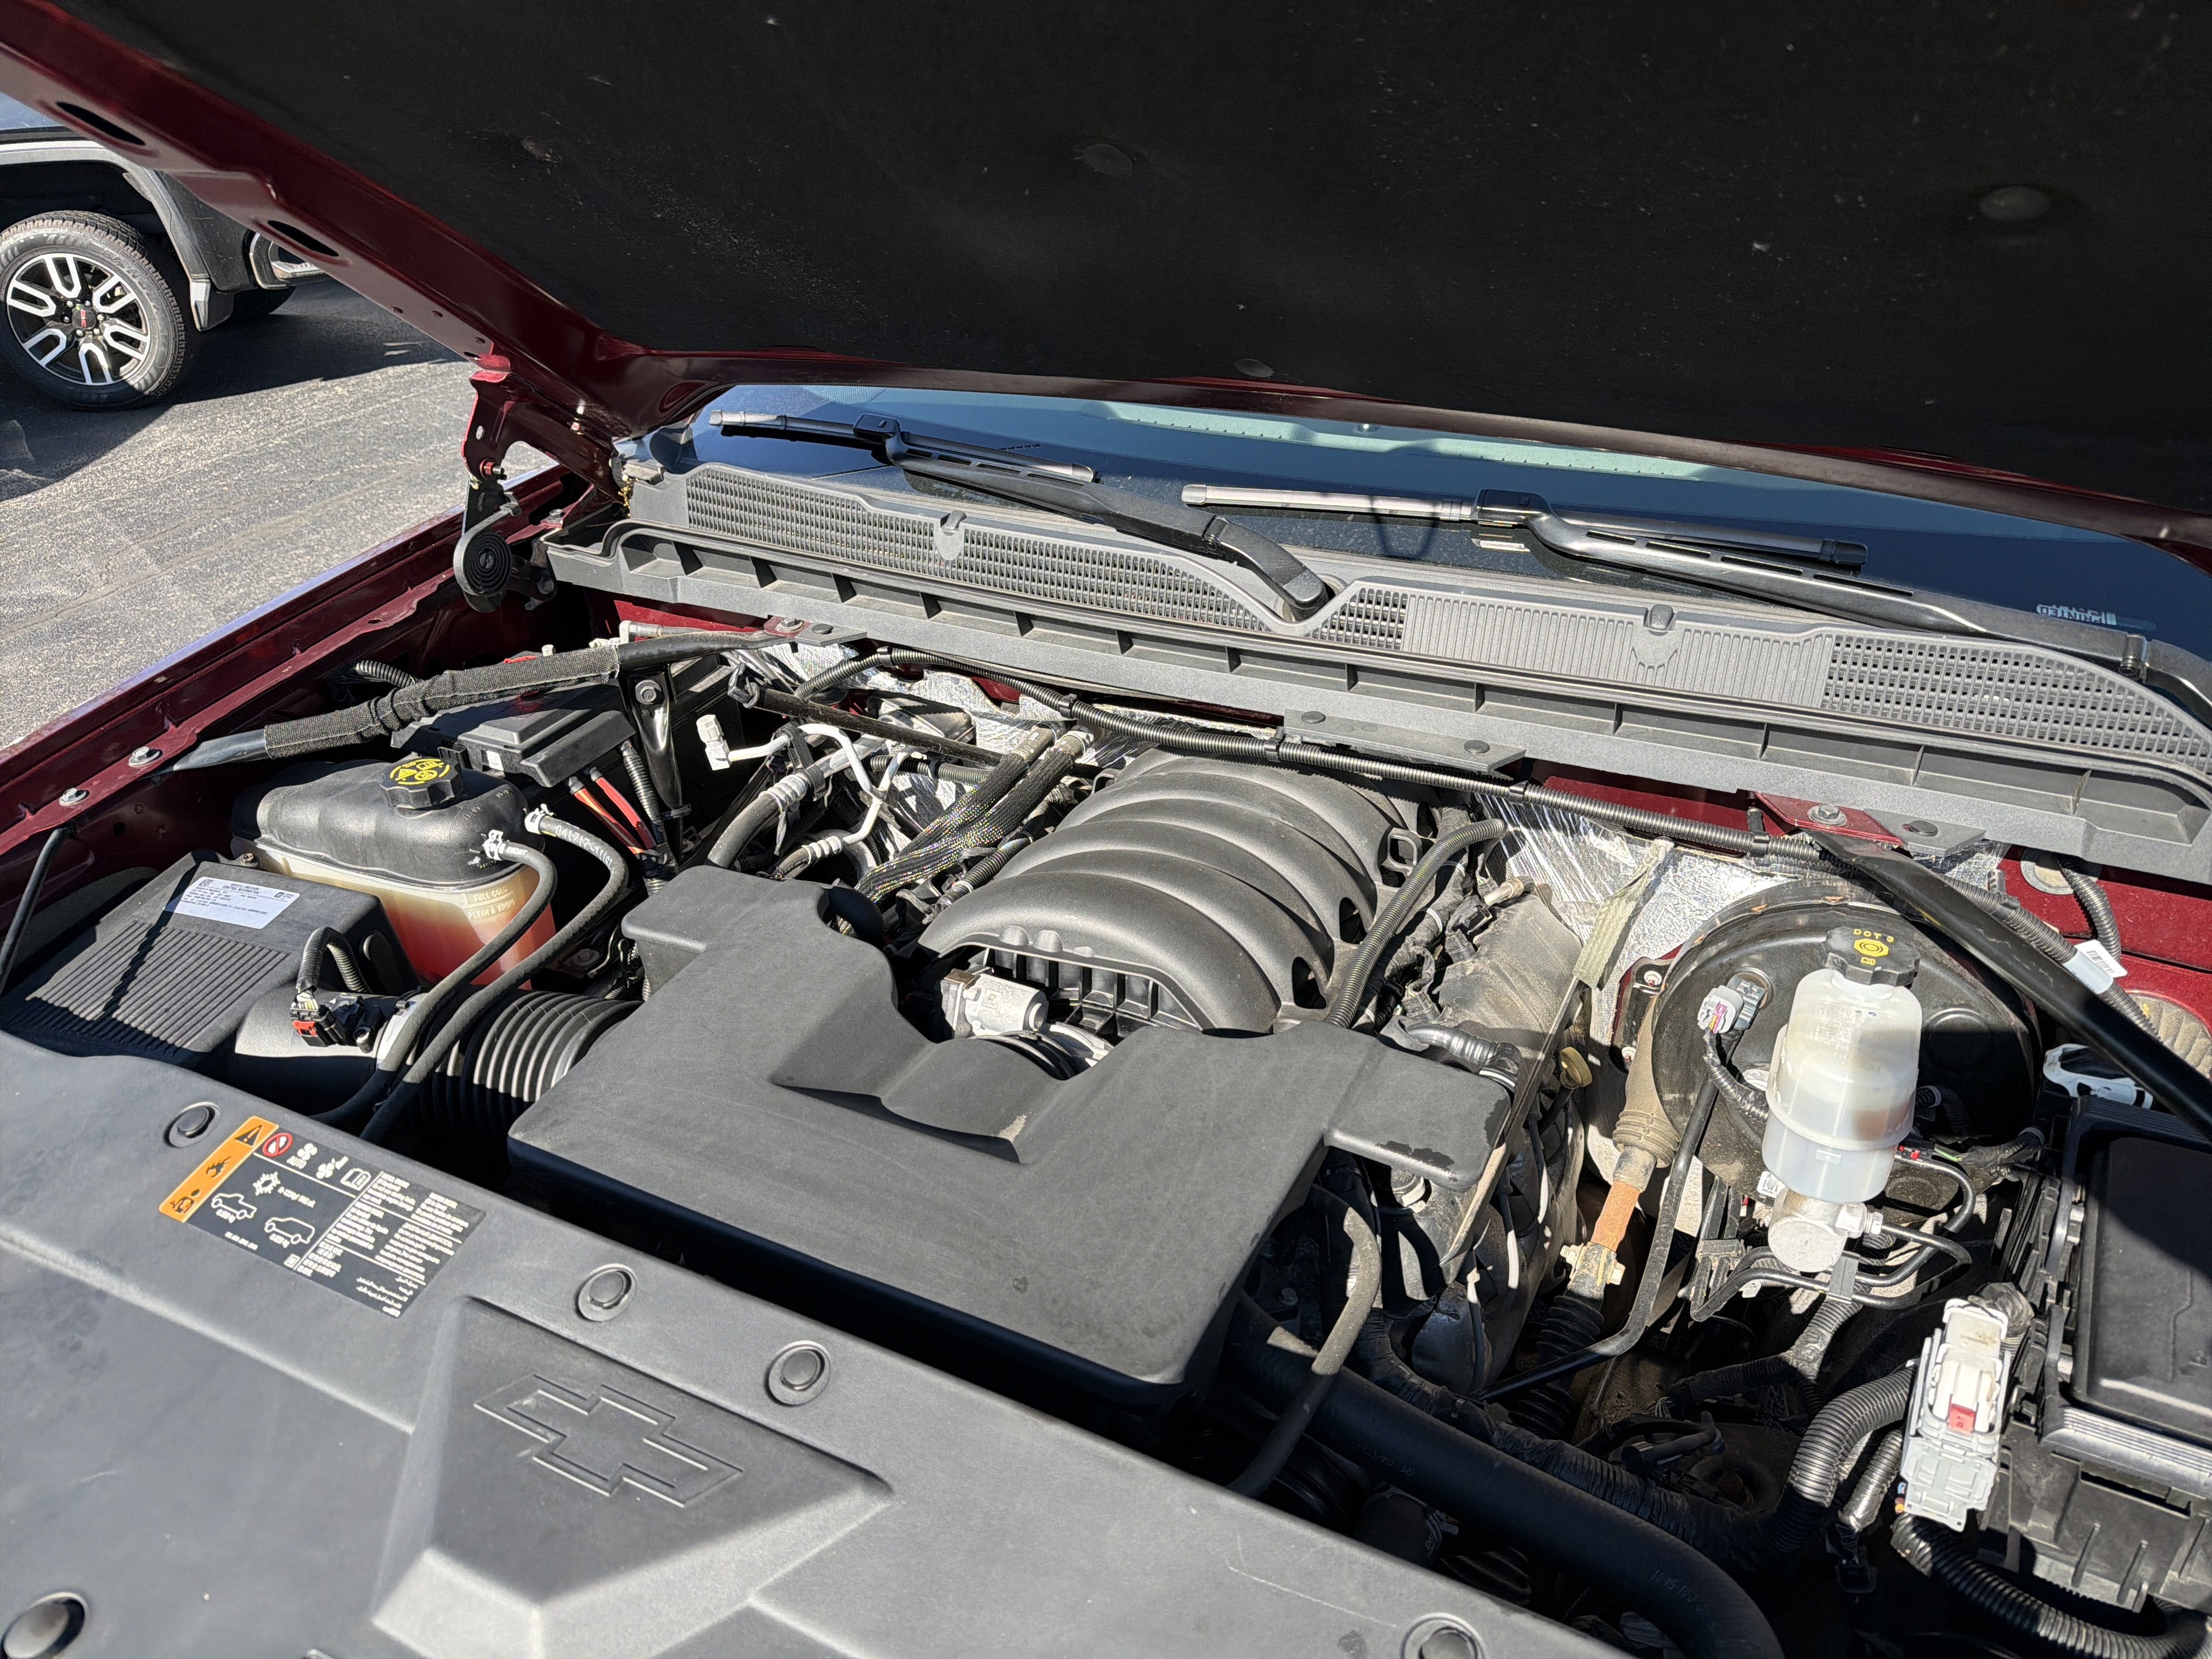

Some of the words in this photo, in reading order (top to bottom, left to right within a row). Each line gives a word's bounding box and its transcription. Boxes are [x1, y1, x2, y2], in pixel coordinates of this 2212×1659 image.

[506, 846, 528, 855] FRONT
[473, 892, 490, 902] FULL
[467, 909, 490, 920] PLEIN
[1853, 928, 1882, 939] DOT
[286, 1155, 307, 1169] AUTO
